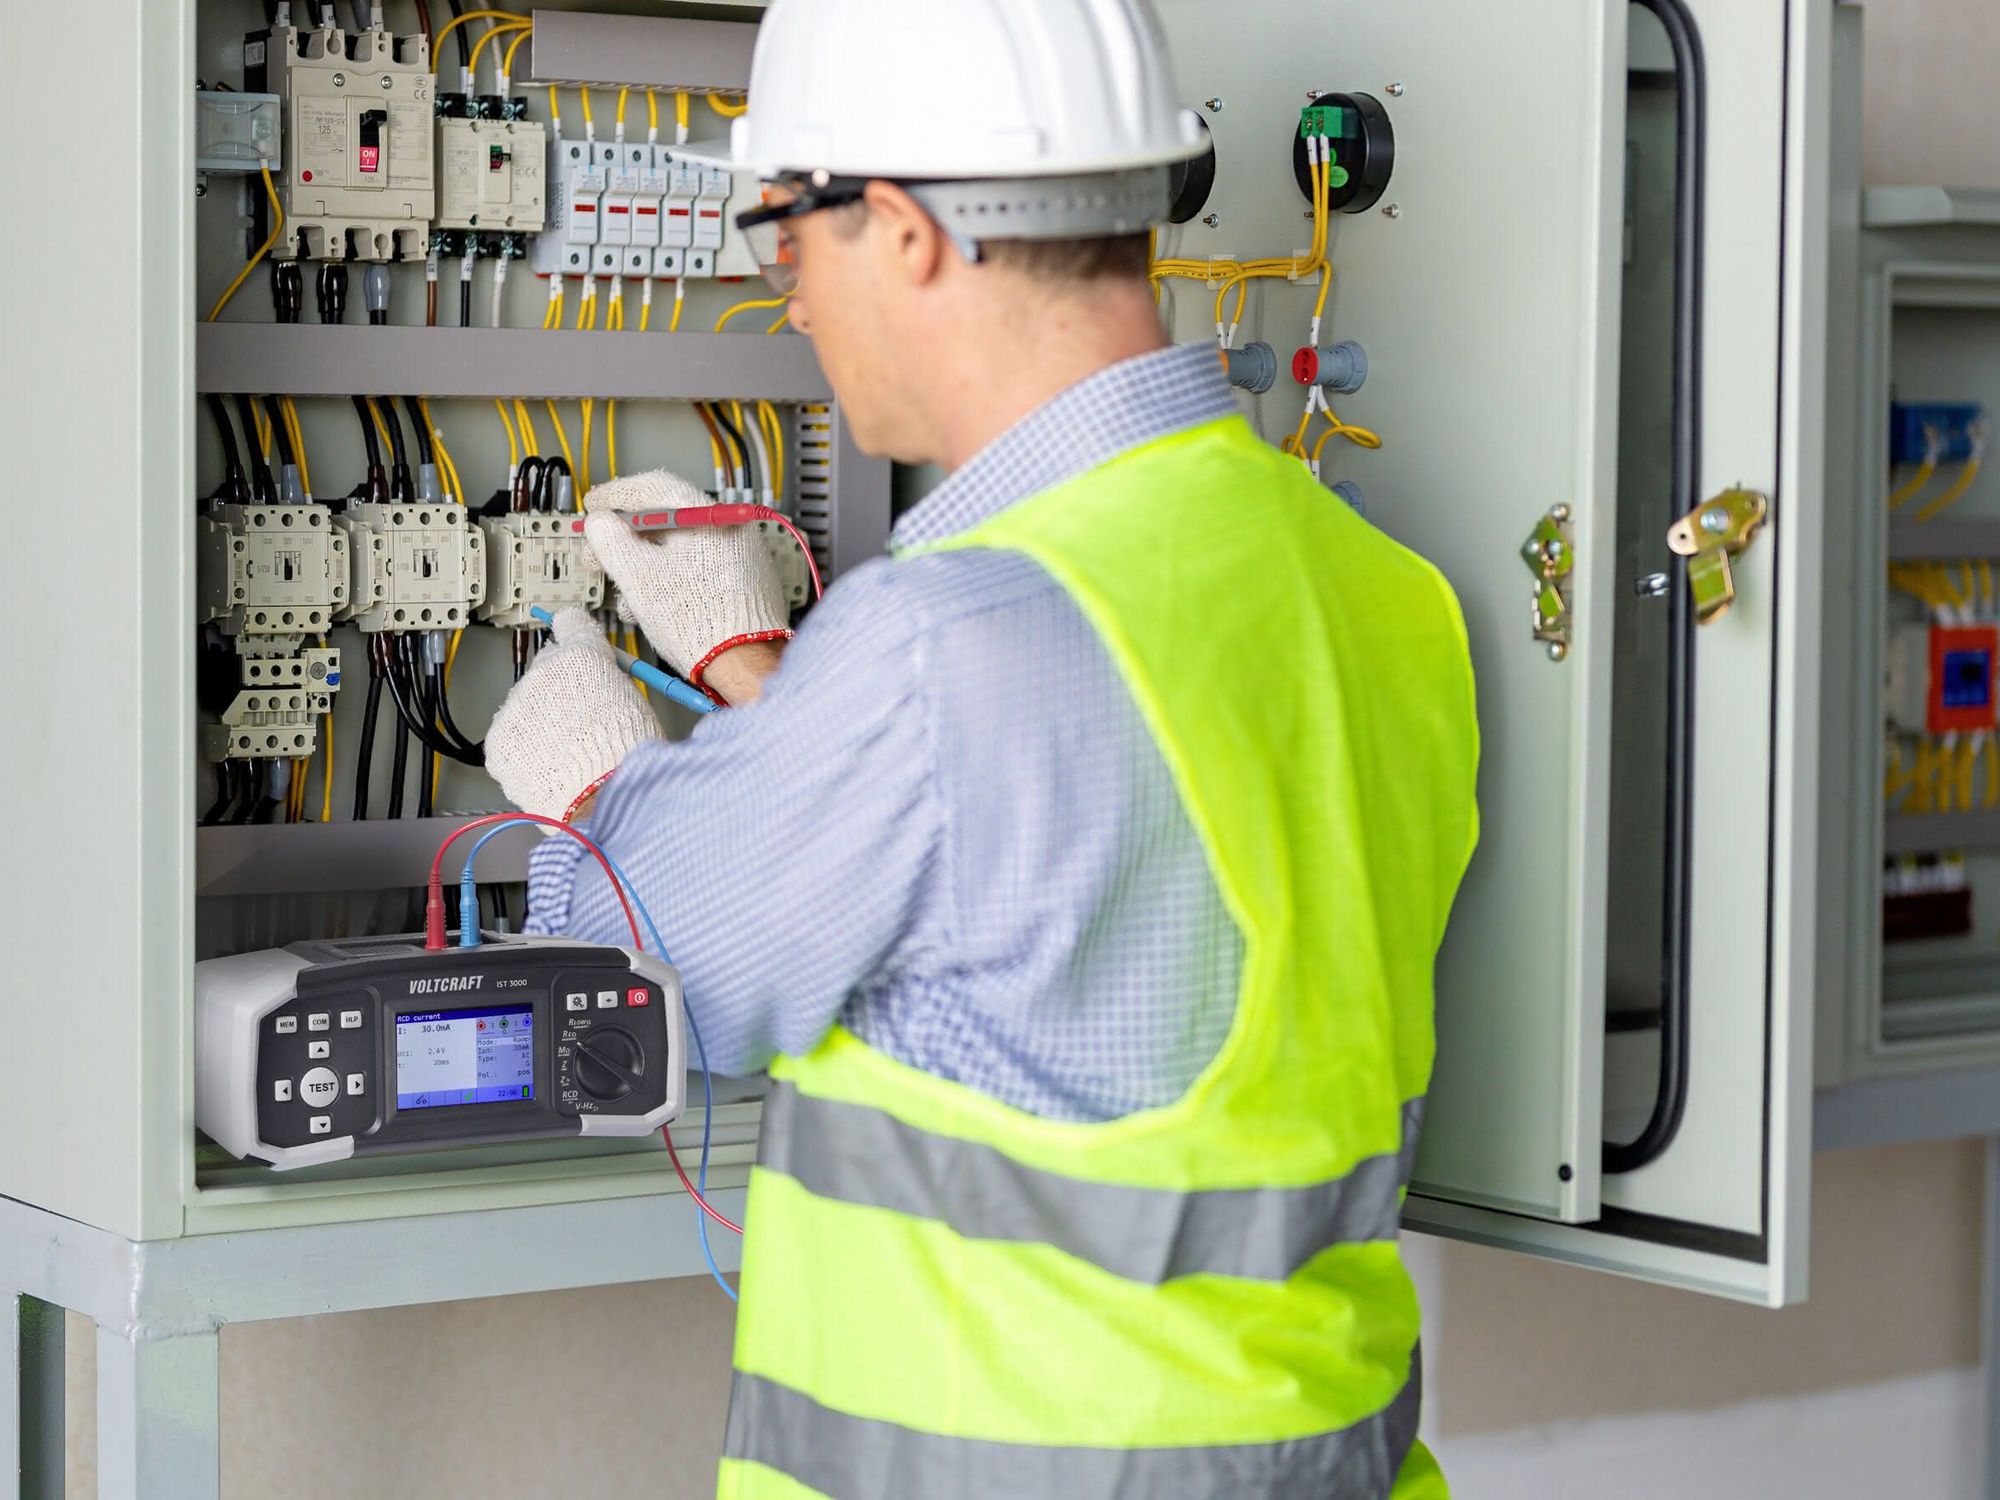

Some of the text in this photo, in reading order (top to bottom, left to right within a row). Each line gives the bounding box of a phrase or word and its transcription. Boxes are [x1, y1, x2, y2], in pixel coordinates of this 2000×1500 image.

[319, 125, 331, 135] 125
[362, 149, 375, 158] ON
[409, 975, 528, 994] VOLTCRAFT IST 3000
[397, 1013, 441, 1023] RCD current
[421, 1024, 451, 1034] 30.0mA
[309, 1082, 335, 1093] TEST
[497, 1089, 518, 1097] 22:06
[562, 1090, 578, 1099] RCD
